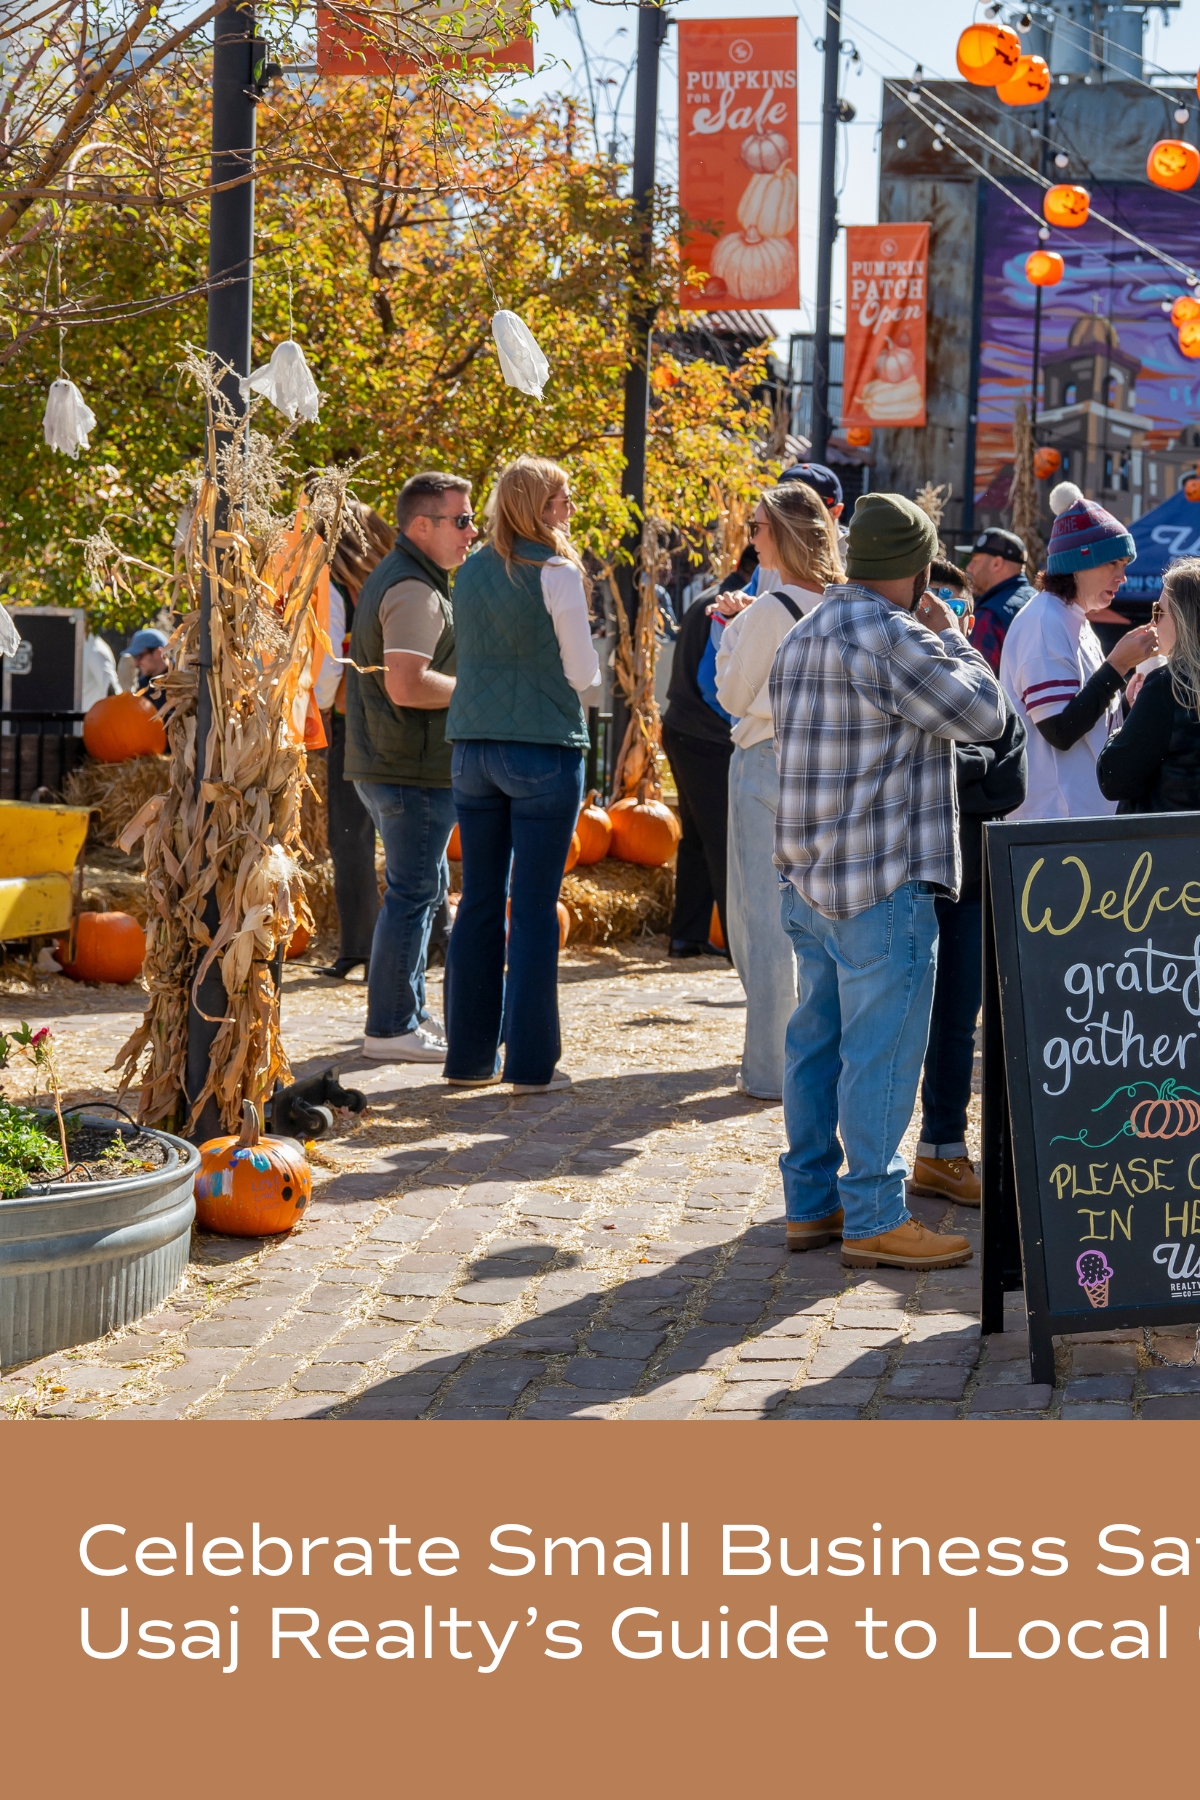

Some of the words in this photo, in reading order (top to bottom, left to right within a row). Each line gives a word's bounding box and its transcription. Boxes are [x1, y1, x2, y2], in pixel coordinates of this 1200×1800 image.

[686, 69, 797, 90] PUMPKINS
[686, 93, 711, 104] FOR
[688, 86, 788, 136] Sale
[851, 260, 924, 276] PUMPKIN
[851, 278, 924, 301] PATCH
[858, 299, 923, 335] Open
[1049, 1157, 1175, 1200] PLEASE
[1077, 1205, 1134, 1242] IN
[1182, 1290, 1192, 1298] CO
